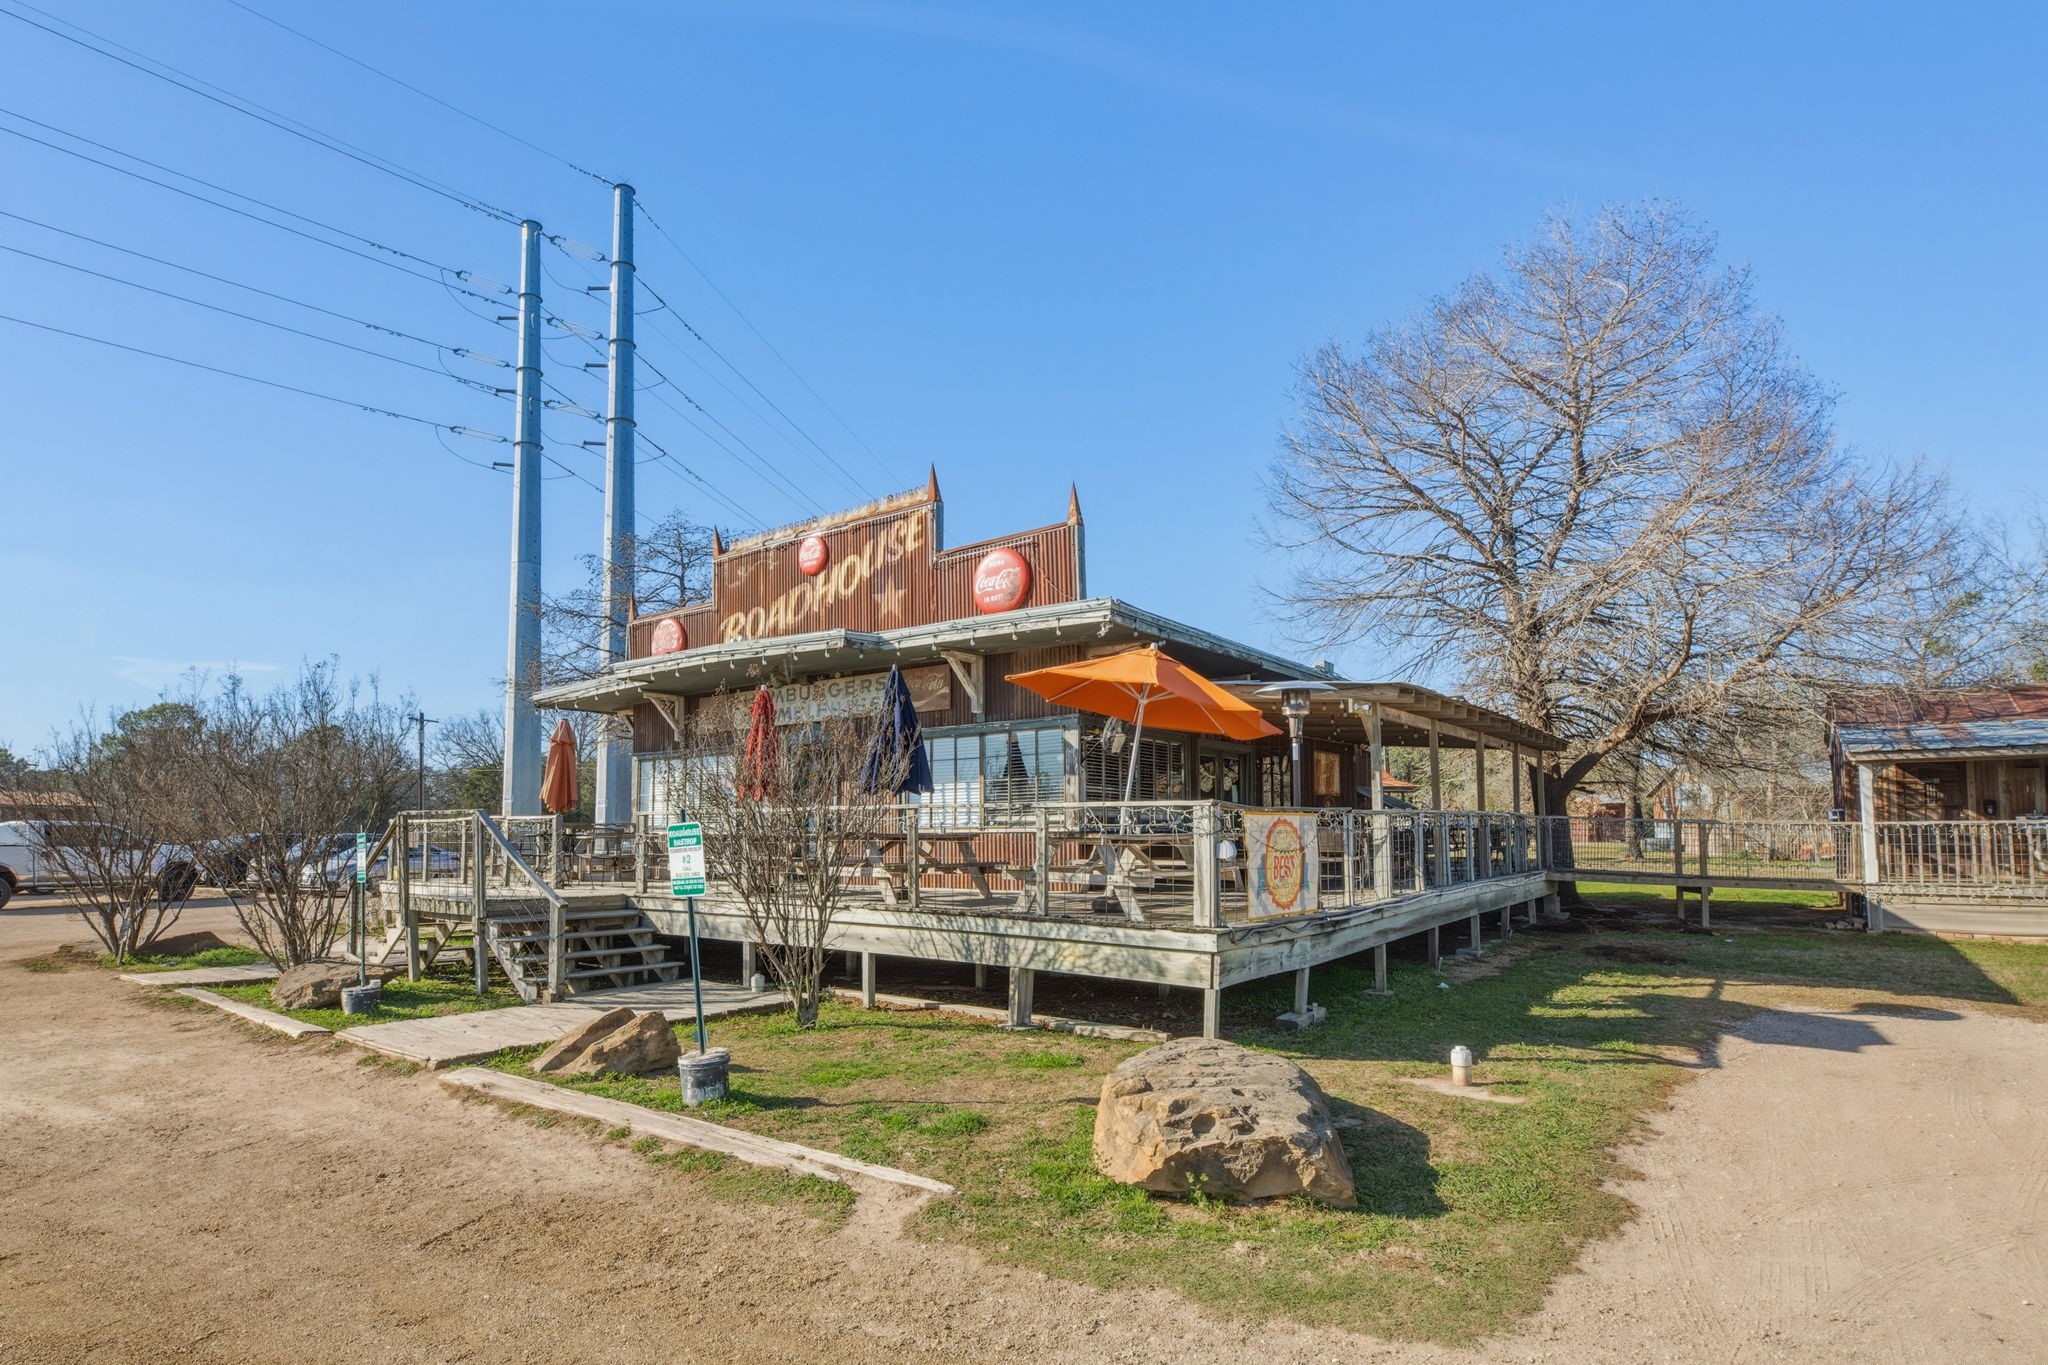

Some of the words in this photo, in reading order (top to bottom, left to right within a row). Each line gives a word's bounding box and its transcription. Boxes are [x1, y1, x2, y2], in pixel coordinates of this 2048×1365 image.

[720, 509, 927, 644] ROADHOUSE
[975, 566, 1021, 594] Coca-Co
[744, 676, 887, 708] MBUGERS
[905, 672, 945, 691] oca-Cola
